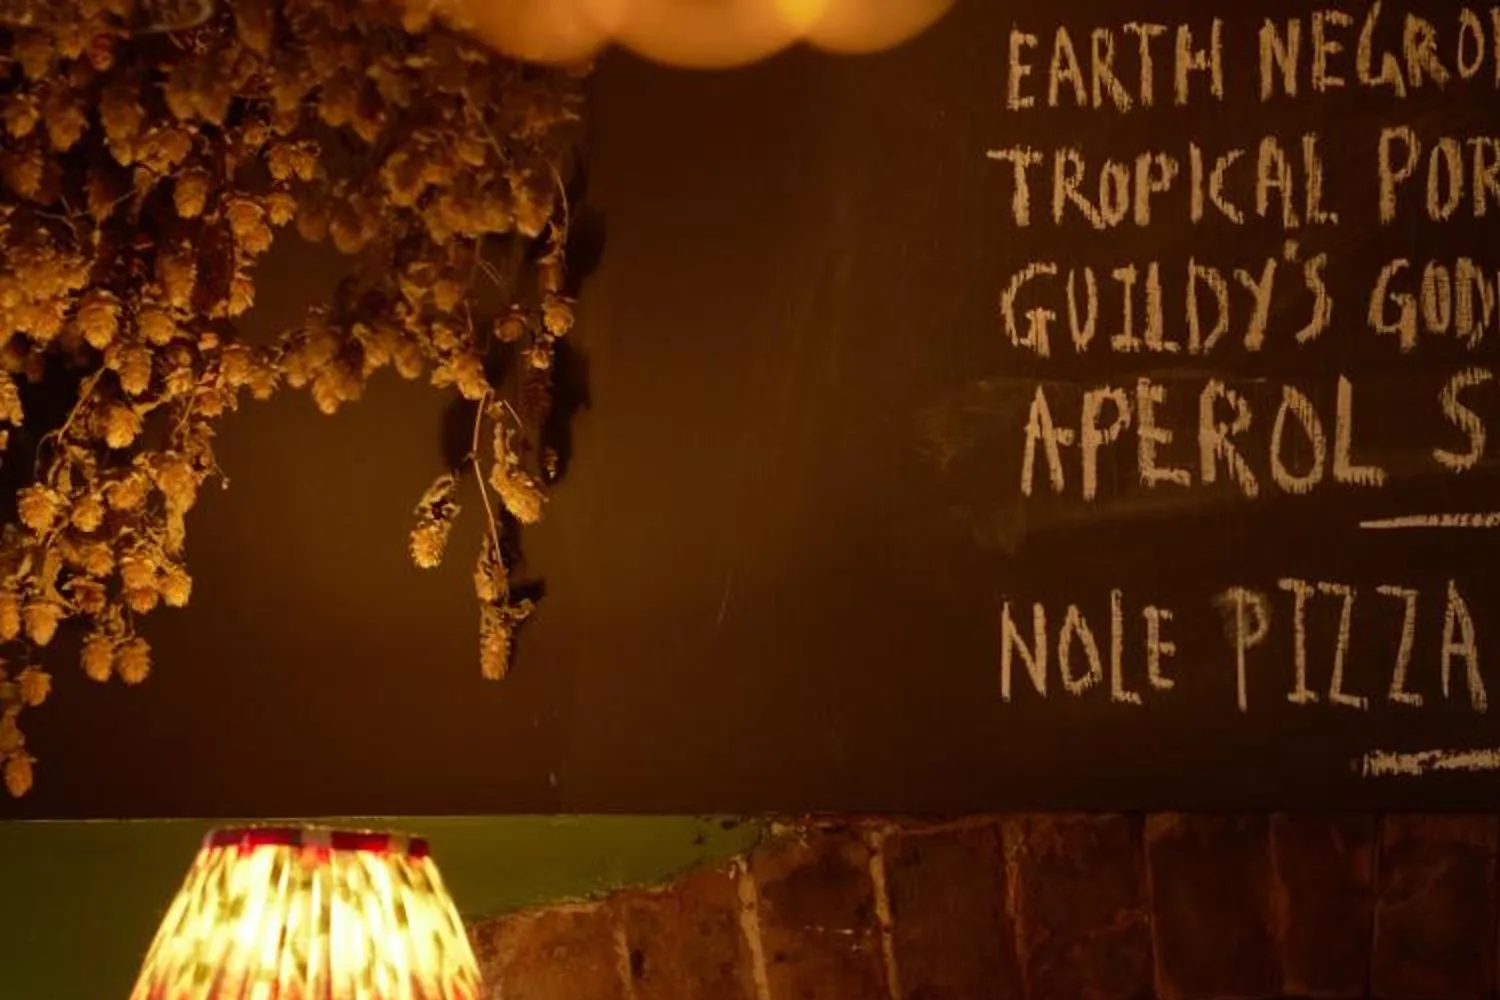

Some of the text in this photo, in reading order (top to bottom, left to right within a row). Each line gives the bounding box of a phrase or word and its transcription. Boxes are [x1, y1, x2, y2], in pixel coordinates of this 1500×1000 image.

[1008, 19, 1223, 113] EARTH
[986, 133, 1339, 229] TROPICAL
[1001, 240, 1333, 356] GUILDY'S
[1021, 375, 1386, 500] APEROL
[1001, 588, 1175, 705] NOLE
[1228, 577, 1488, 713] PIZZA
